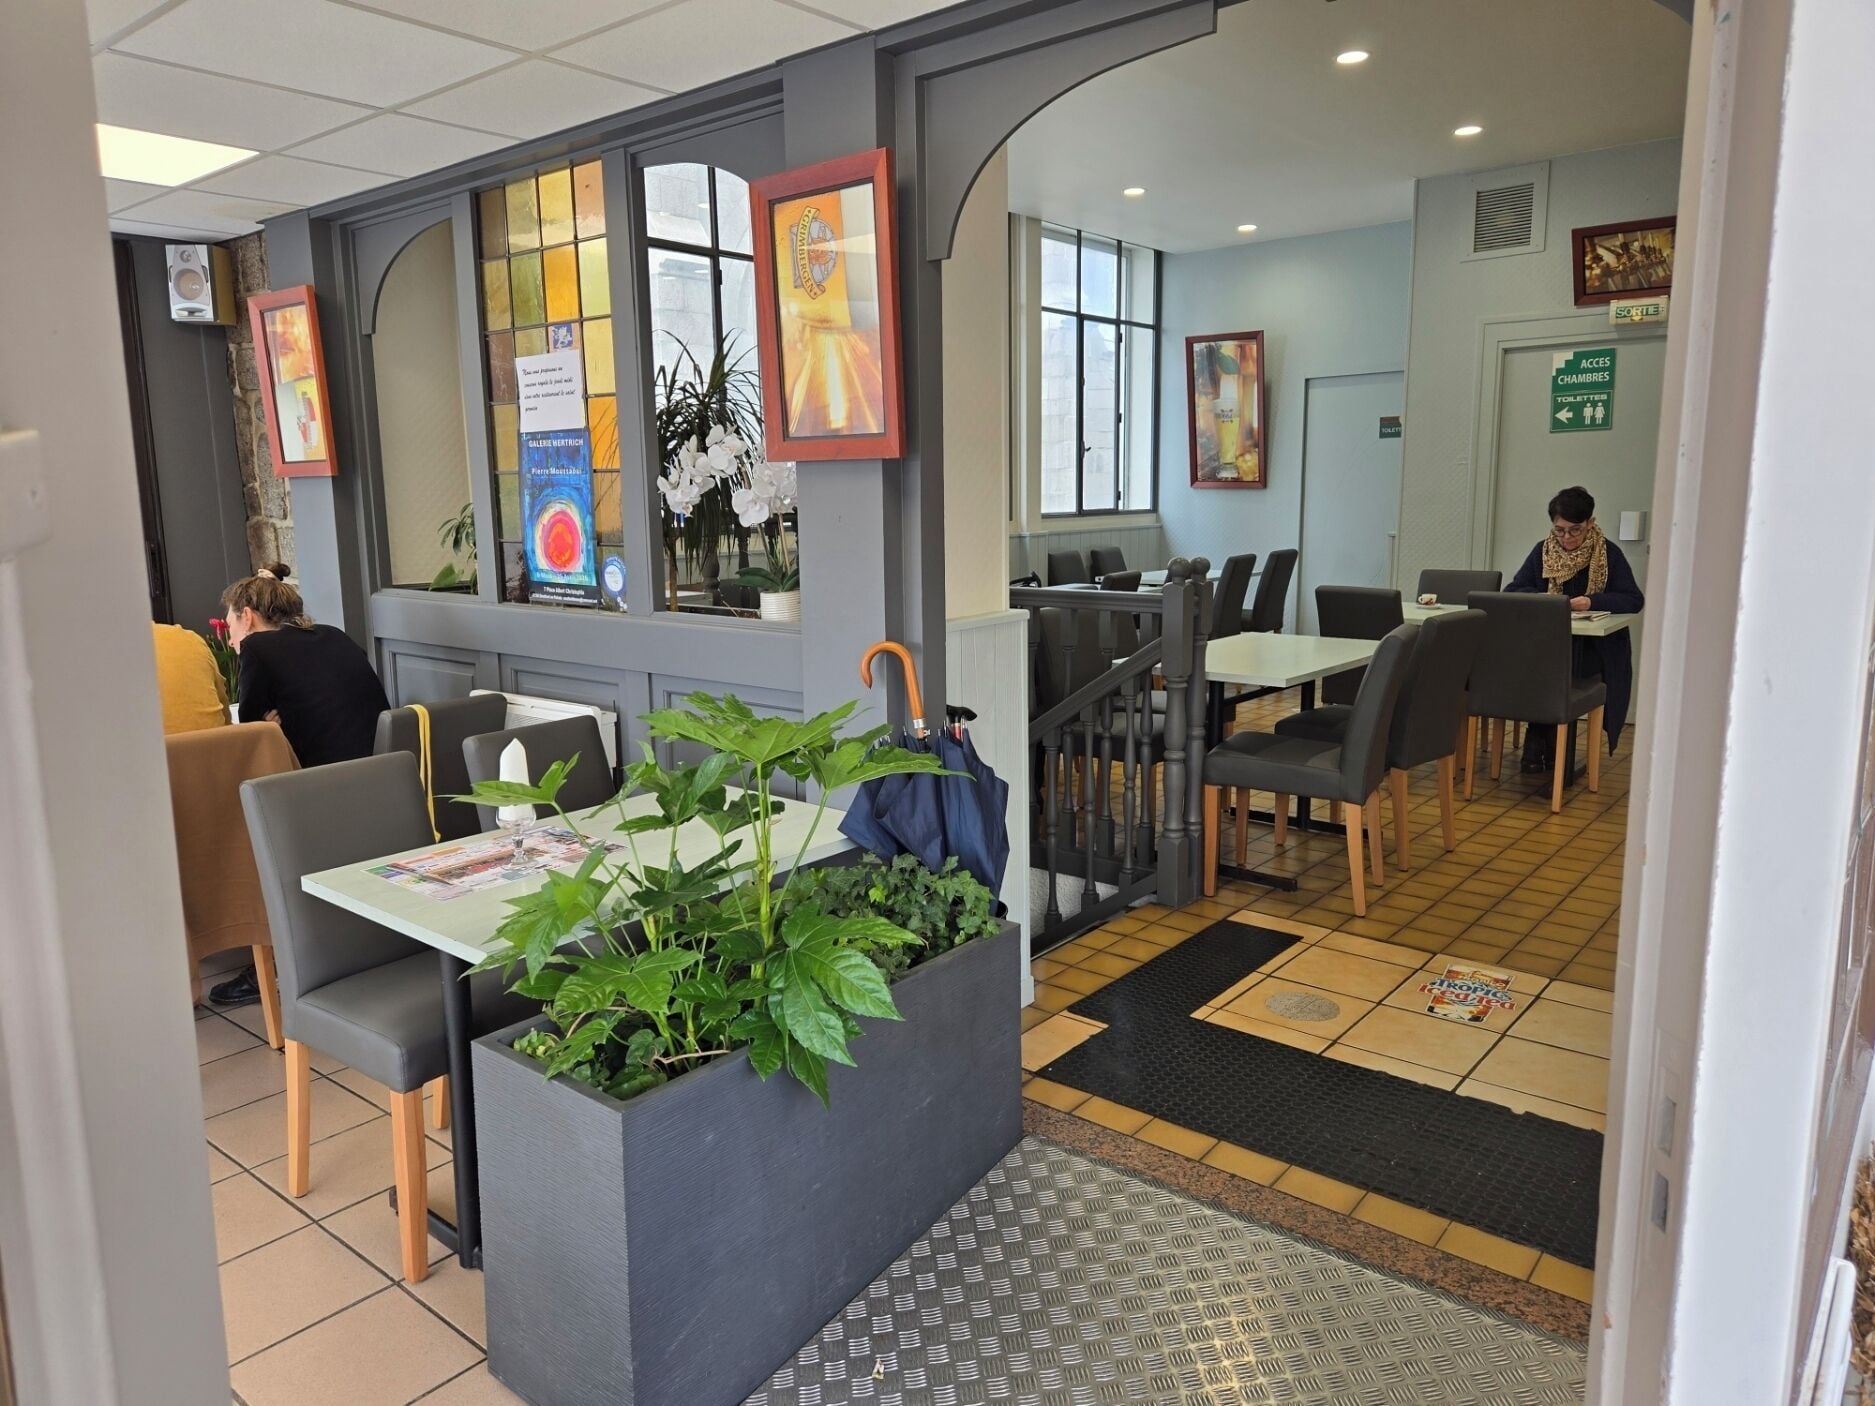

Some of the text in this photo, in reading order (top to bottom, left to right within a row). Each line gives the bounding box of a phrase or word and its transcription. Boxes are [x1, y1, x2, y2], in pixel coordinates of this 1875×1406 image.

[798, 213, 816, 294] GRIMBERGEN
[1616, 305, 1659, 318] SORTIE
[1581, 357, 1611, 369] ACCES
[1557, 371, 1610, 385] CHAMBRES
[1556, 394, 1608, 403] TOILETTES
[528, 439, 552, 448] GALERIE
[531, 467, 549, 475] Pierre
